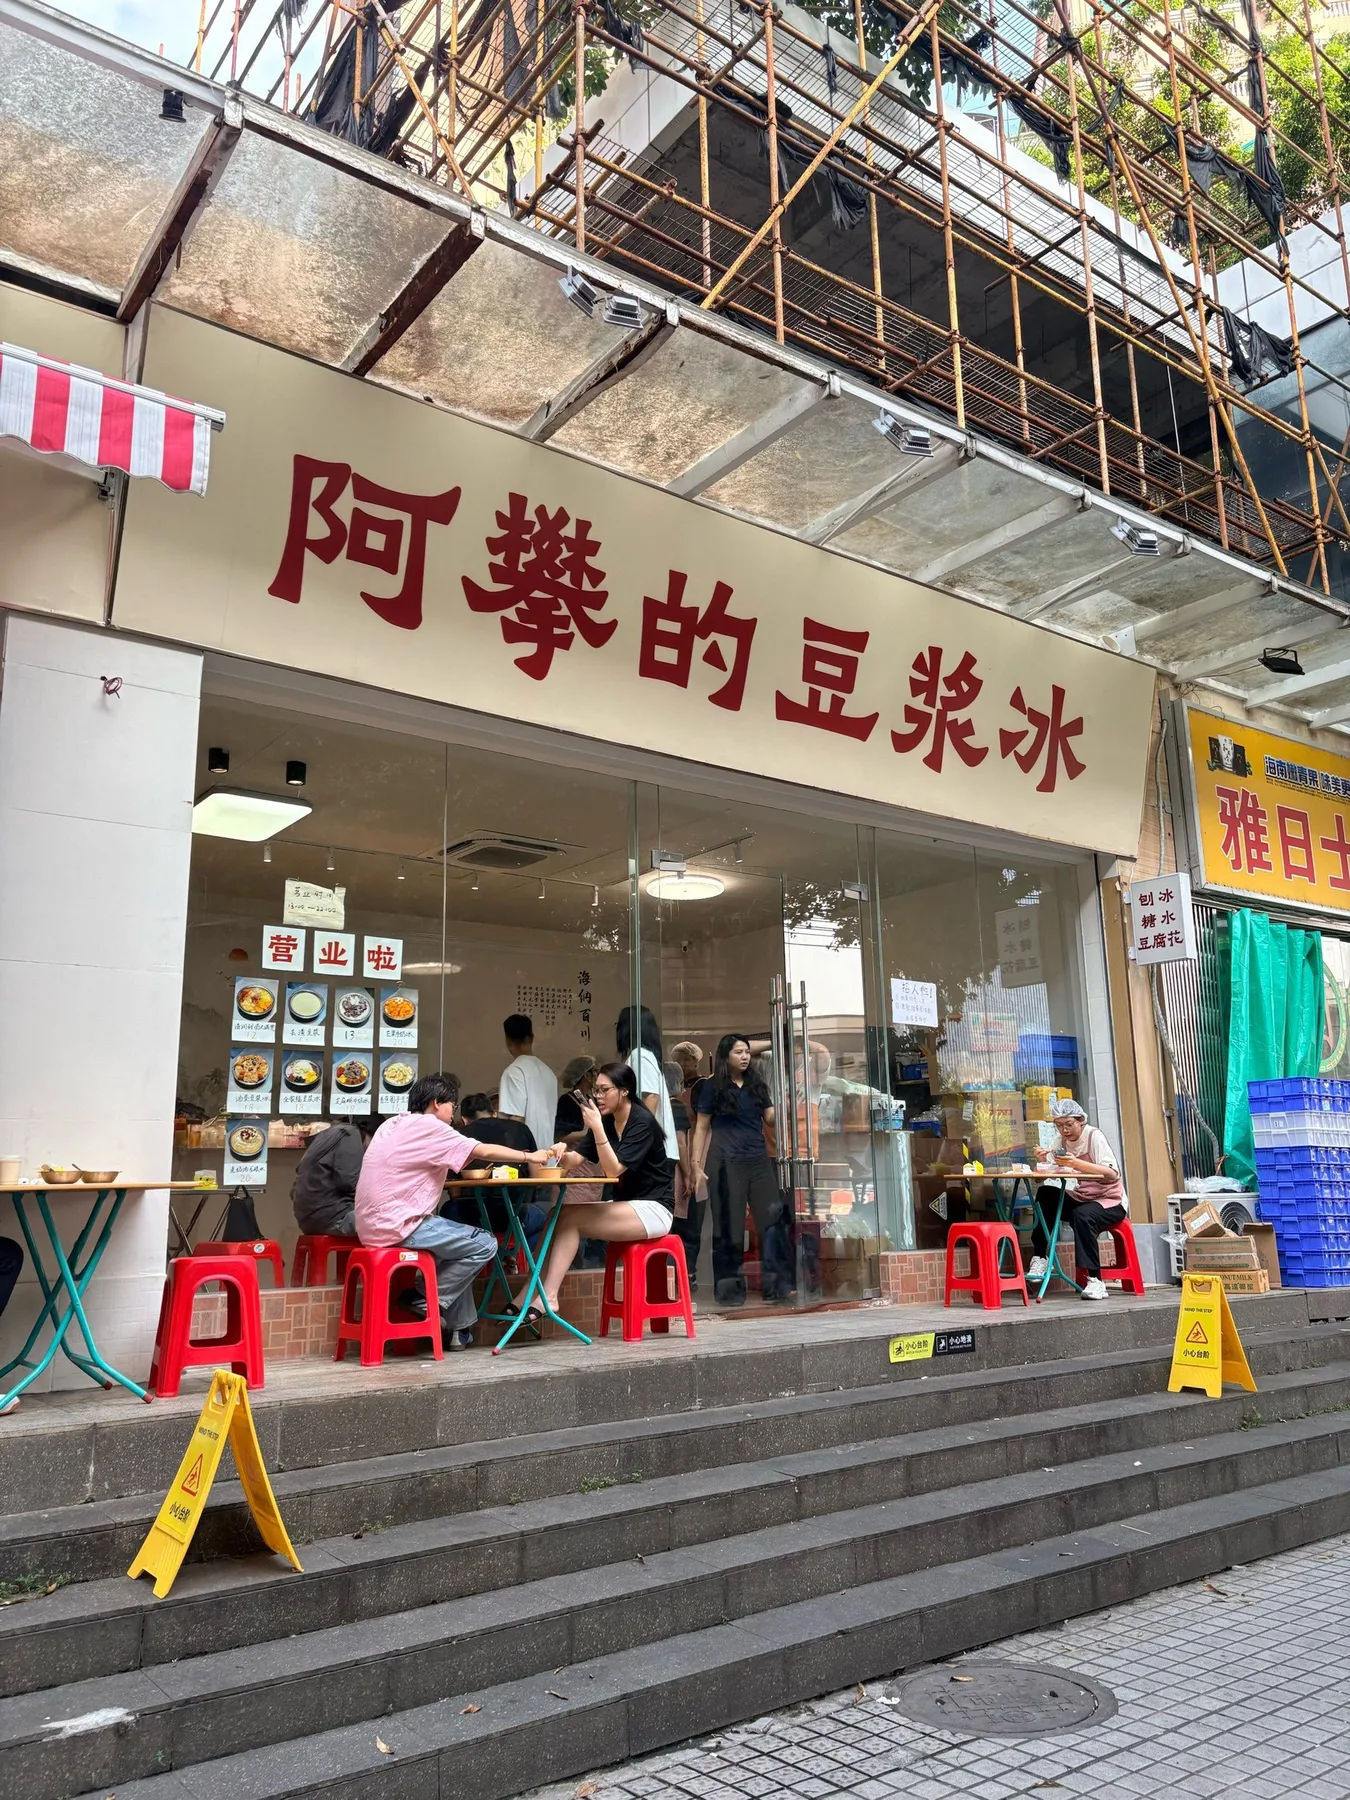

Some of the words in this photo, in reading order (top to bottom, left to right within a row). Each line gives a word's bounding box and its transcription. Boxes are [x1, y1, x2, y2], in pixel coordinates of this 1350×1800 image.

[267, 453, 1086, 793] 阿攀的豆浆冰
[1139, 888, 1174, 906] 刨冰
[1141, 910, 1176, 929] 糖水
[1138, 930, 1184, 950] 豆腐花
[268, 935, 397, 971] 营业啦
[577, 970, 592, 1041] 海纳百川
[905, 1340, 929, 1350] 小心台阶
[1183, 1349, 1210, 1359] 小心台阶
[169, 1501, 190, 1524] 小心台阶
